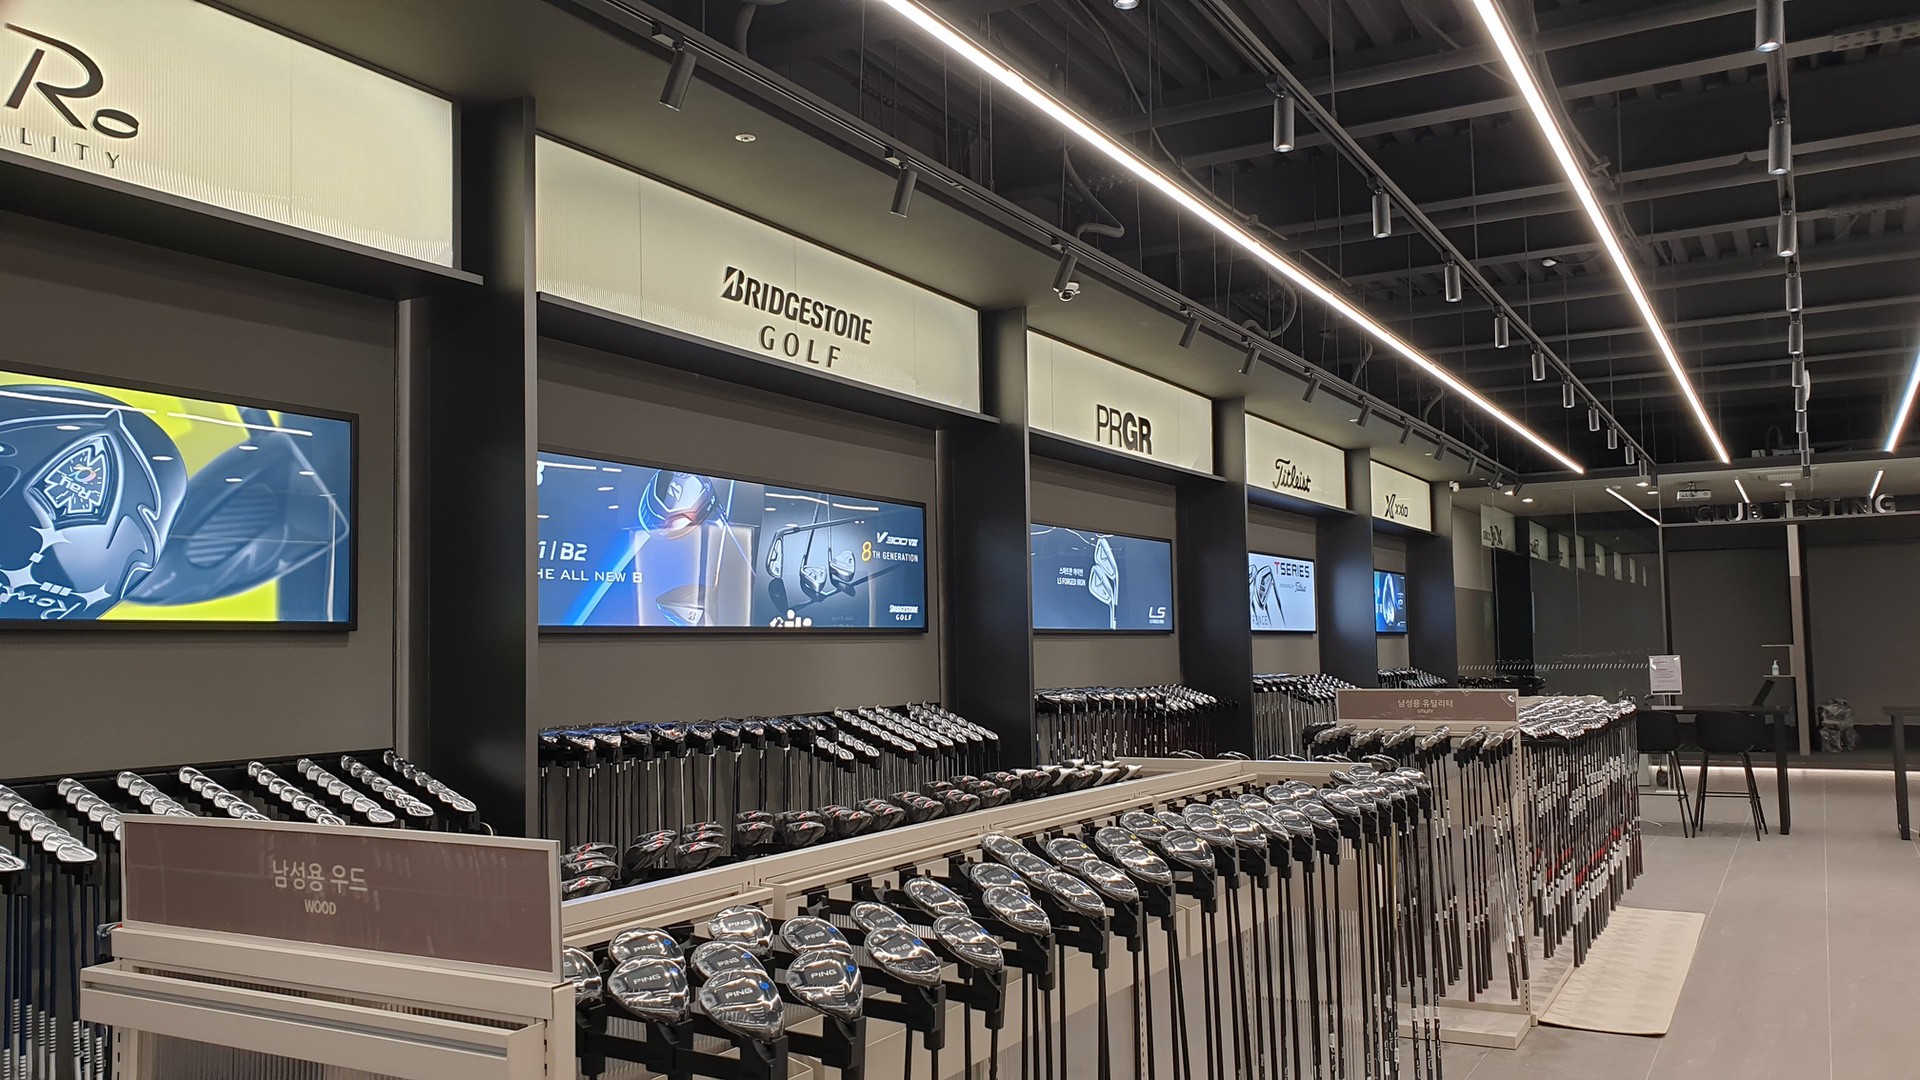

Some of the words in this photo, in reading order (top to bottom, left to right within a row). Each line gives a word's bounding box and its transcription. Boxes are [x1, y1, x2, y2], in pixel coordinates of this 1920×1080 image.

[720, 266, 873, 345] BRIDGESTONE
[760, 325, 841, 368] GOLF
[1096, 404, 1152, 455] PRGR
[1272, 458, 1312, 493] Titleist
[882, 551, 919, 563] GENERATION
[560, 569, 590, 581] ALL
[594, 570, 627, 583] NEW
[632, 571, 643, 584] B
[895, 613, 913, 621] GOLF
[1148, 606, 1166, 619] LS
[1397, 699, 1421, 708] 남성용
[272, 859, 325, 892] 남성용
[330, 864, 368, 894] 우드
[304, 898, 337, 915] WOOD
[727, 919, 751, 928] PING
[804, 930, 825, 941] PING
[633, 942, 658, 953] PING
[717, 956, 740, 967] PING
[633, 973, 661, 985] PING
[810, 968, 838, 979] PING
[725, 987, 754, 999] PING
